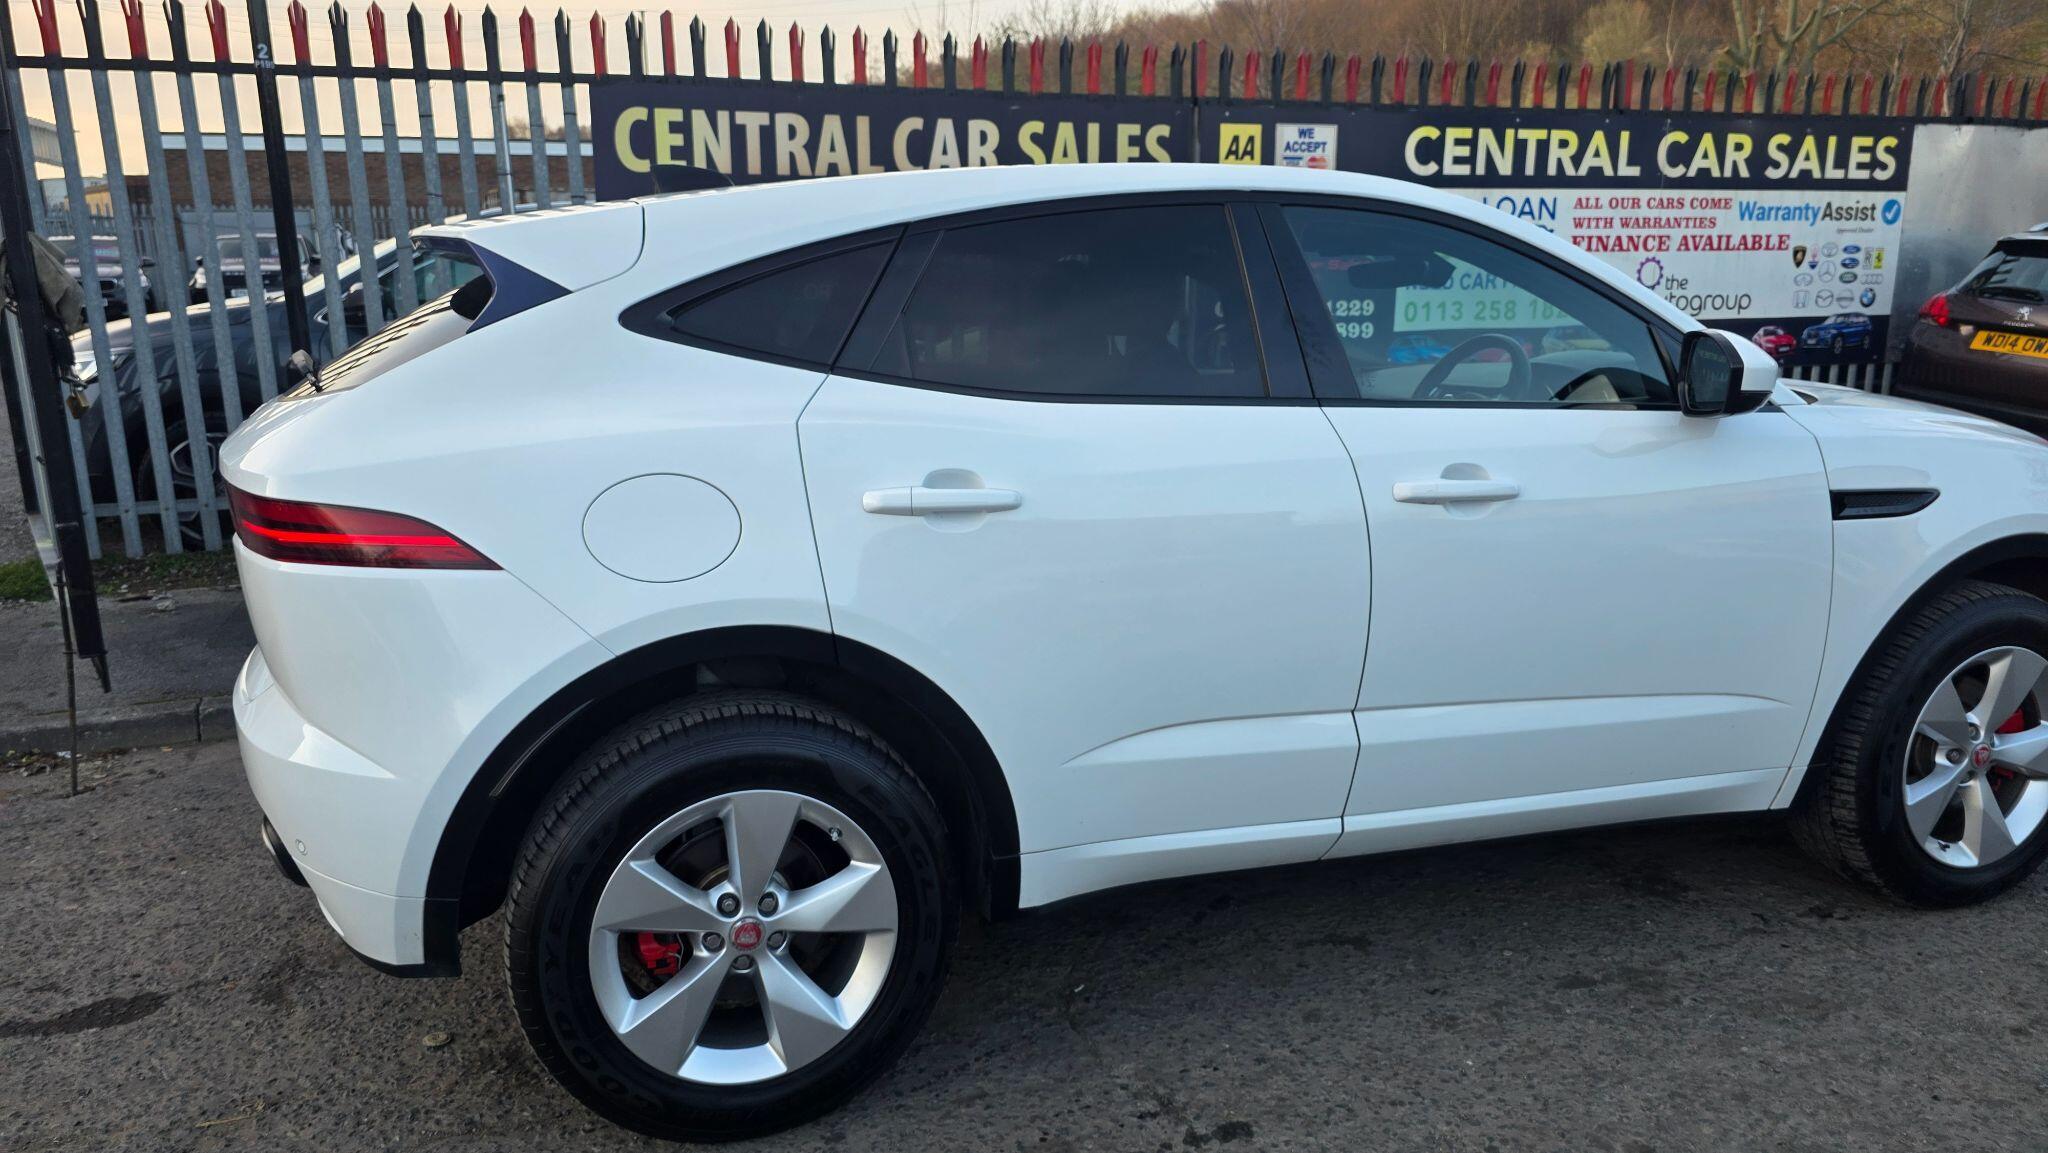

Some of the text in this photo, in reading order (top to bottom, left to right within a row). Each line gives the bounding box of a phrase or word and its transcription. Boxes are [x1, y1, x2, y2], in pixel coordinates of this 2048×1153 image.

[257, 43, 269, 59] 2
[613, 106, 1172, 176] CENTRAL CAR SALES
[1298, 128, 1315, 139] WE
[1224, 134, 1255, 161] AA
[1284, 141, 1327, 153] ACCEPT
[1404, 126, 1898, 181] CENTRAL CAR SALES
[1483, 195, 1557, 221] OAN
[1573, 197, 1733, 210] ALL OUR CARS COME
[1573, 216, 1717, 230] WITH WARRANTIES
[1571, 234, 1790, 252] FINANCE AVAILABLE
[1665, 274, 1688, 290] the
[1404, 300, 1463, 323] 0113
[1473, 300, 1517, 322] 258
[1665, 292, 1752, 317] togroup
[1982, 333, 2020, 351] WD14
